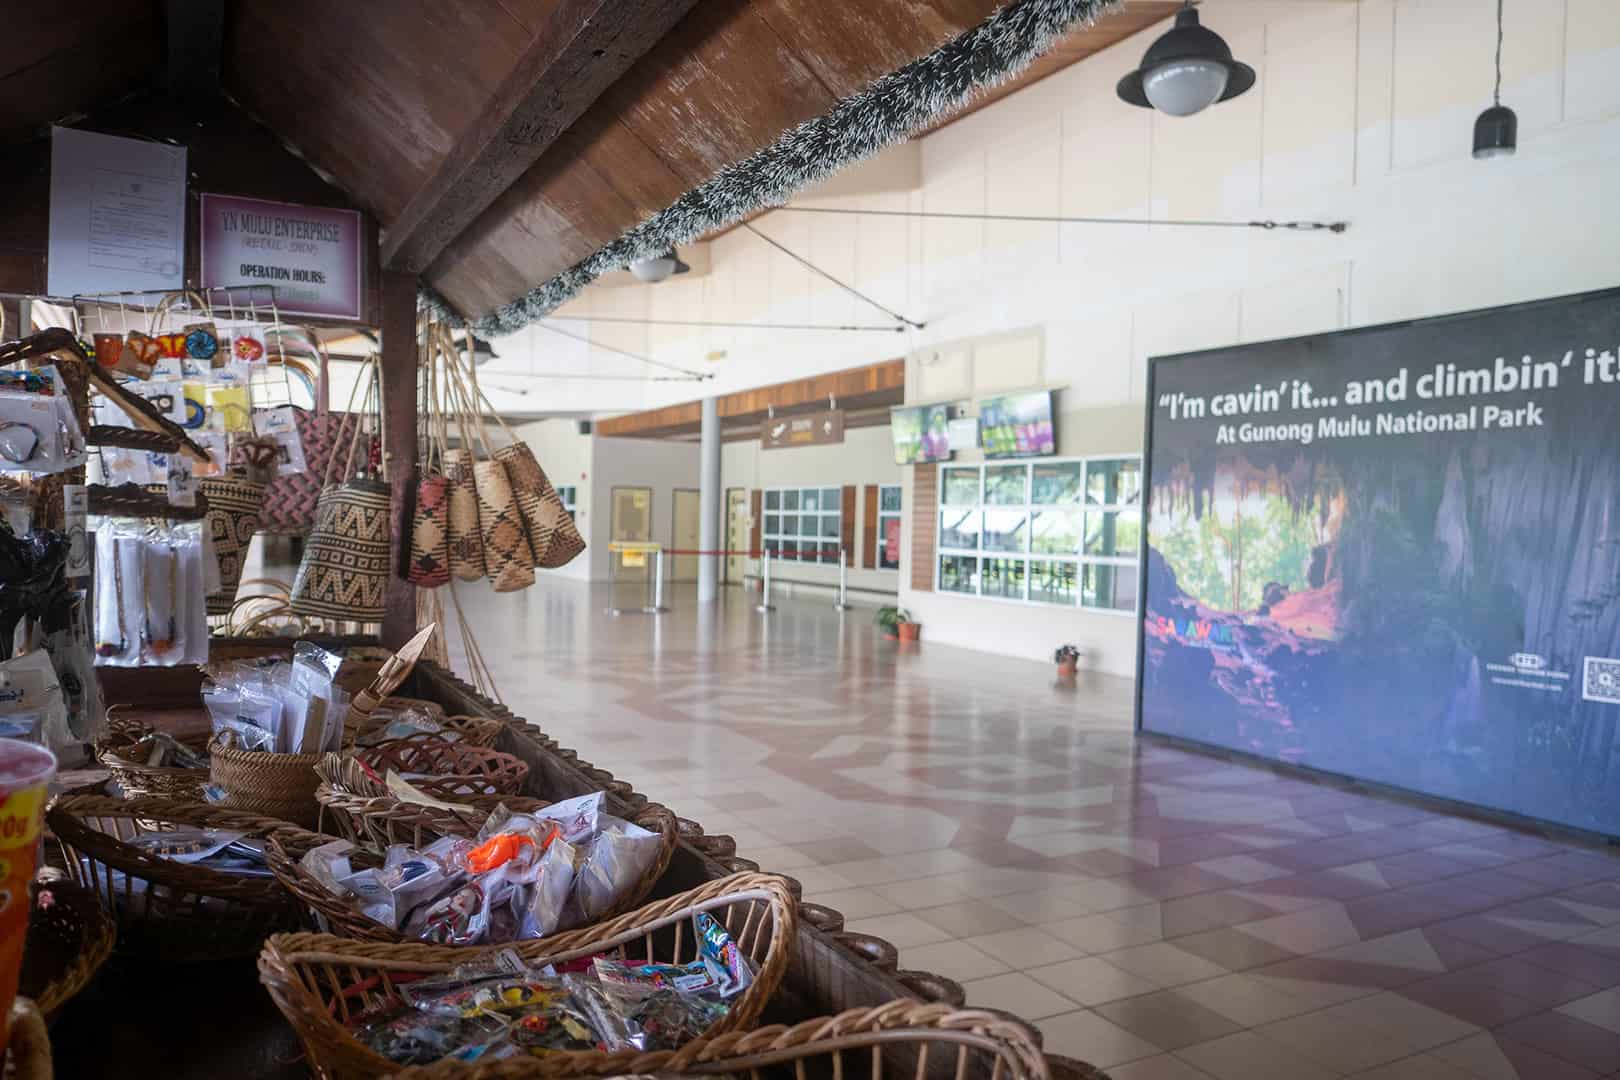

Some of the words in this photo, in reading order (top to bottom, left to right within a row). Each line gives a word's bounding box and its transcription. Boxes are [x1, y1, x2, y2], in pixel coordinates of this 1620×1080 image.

[240, 213, 273, 236] MULU
[274, 218, 340, 242] ENTERPRISE
[240, 263, 290, 281] OPERATION
[292, 269, 326, 284] HOURS:
[1211, 380, 1288, 416] cavin'
[1344, 367, 1408, 405] and
[1215, 423, 1236, 444] At
[1239, 421, 1313, 445] Gunong
[1317, 414, 1371, 439] Mulu
[1375, 404, 1477, 435] National
[1482, 400, 1544, 429] Park
